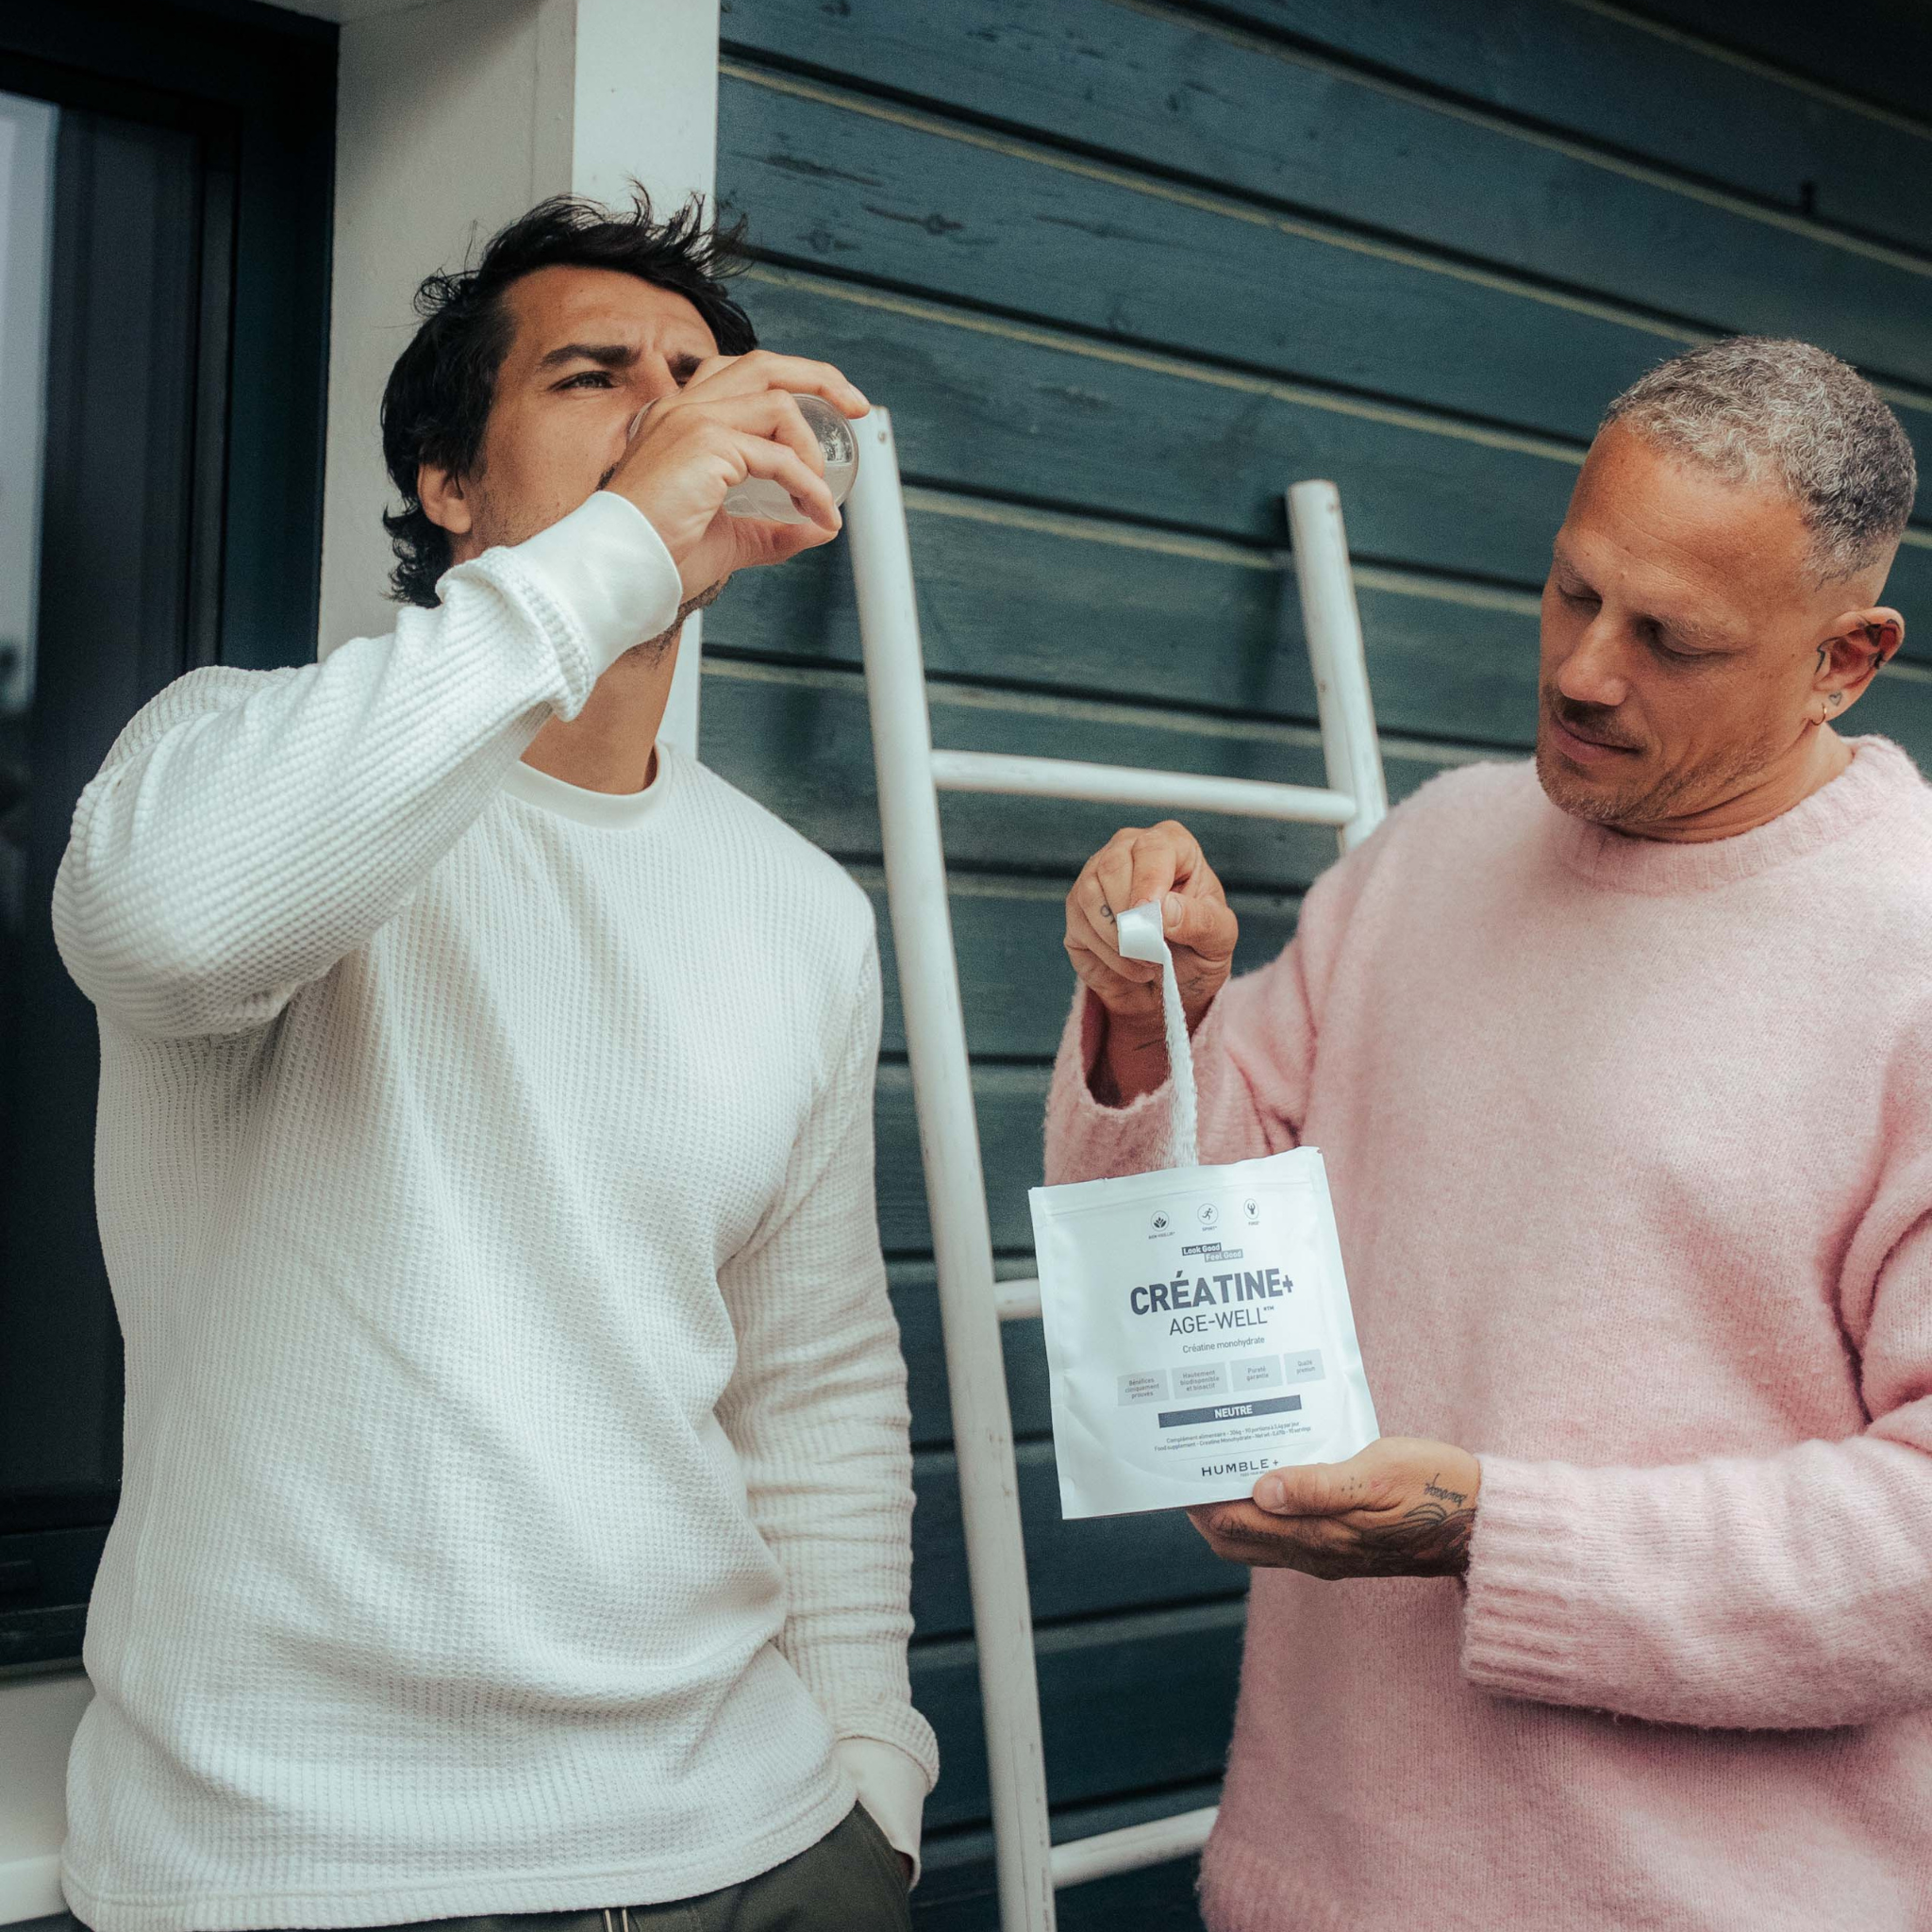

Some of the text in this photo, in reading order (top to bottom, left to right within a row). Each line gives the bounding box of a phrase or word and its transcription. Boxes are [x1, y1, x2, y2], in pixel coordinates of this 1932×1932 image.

[1183, 1244, 1221, 1255] Look Good
[1206, 1250, 1242, 1261] Feel Good
[1130, 1268, 1293, 1315] CRÉATINE+
[1182, 1337, 1265, 1354] Créatine monohydrate
[1182, 1370, 1216, 1378] Hautement
[1128, 1378, 1155, 1387] Bénéfices
[1124, 1383, 1159, 1393] cliniquement
[1214, 1405, 1253, 1419] NEUTRE
[1198, 1431, 1226, 1440] alimentaire
[1167, 1441, 1196, 1451] supplement
